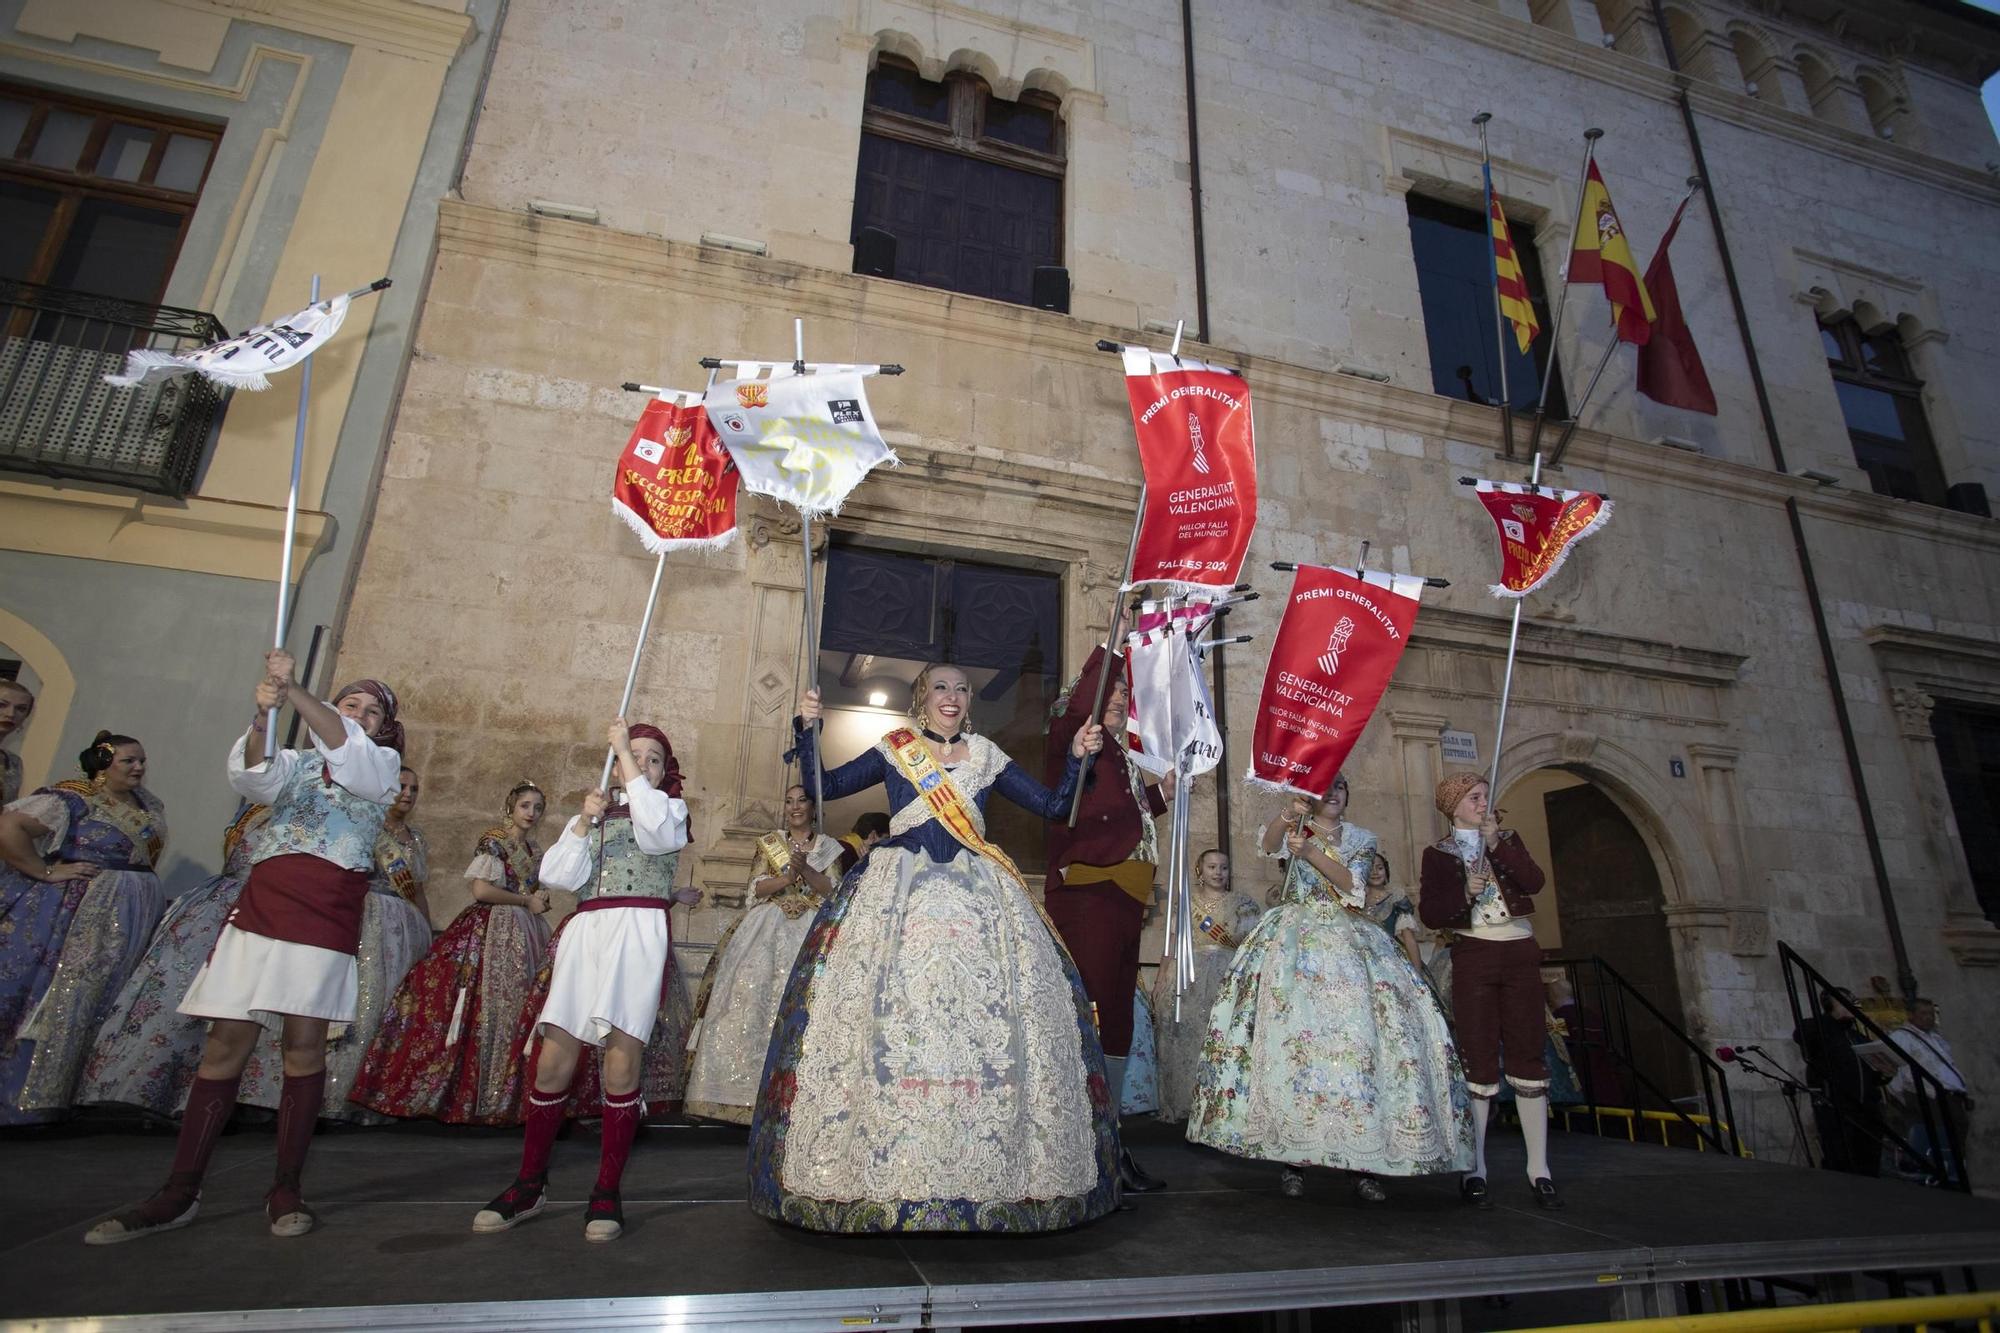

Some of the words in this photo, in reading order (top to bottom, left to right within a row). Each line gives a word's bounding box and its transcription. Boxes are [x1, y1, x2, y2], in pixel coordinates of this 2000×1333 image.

[1141, 395, 1170, 424] PREMI
[1171, 386, 1242, 411] GENERALITAT
[625, 469, 673, 499] SECCIÓ
[656, 467, 715, 490] PREMI
[1169, 480, 1235, 503] GENERALITAT
[1169, 496, 1236, 515] VALENCIANA
[1178, 522, 1206, 532] MILLOR
[1207, 520, 1229, 529] FALLA
[1178, 531, 1192, 539] DEL
[1194, 530, 1228, 538] MUNICIPI
[1158, 559, 1203, 570] FALLES
[1296, 588, 1333, 604] PREMI
[1336, 589, 1401, 640] GENERALITAT
[1275, 683, 1344, 718] VALENCIANA
[1279, 671, 1354, 707] GENERALITAT
[1276, 719, 1289, 730] DEL
[1288, 712, 1306, 724] FALLA
[1307, 719, 1341, 739] INFANTIL
[916, 764, 932, 778] 2024
[1262, 751, 1288, 767] FALLES
[1289, 761, 1313, 775] 2024
[1674, 762, 1681, 777] 6
